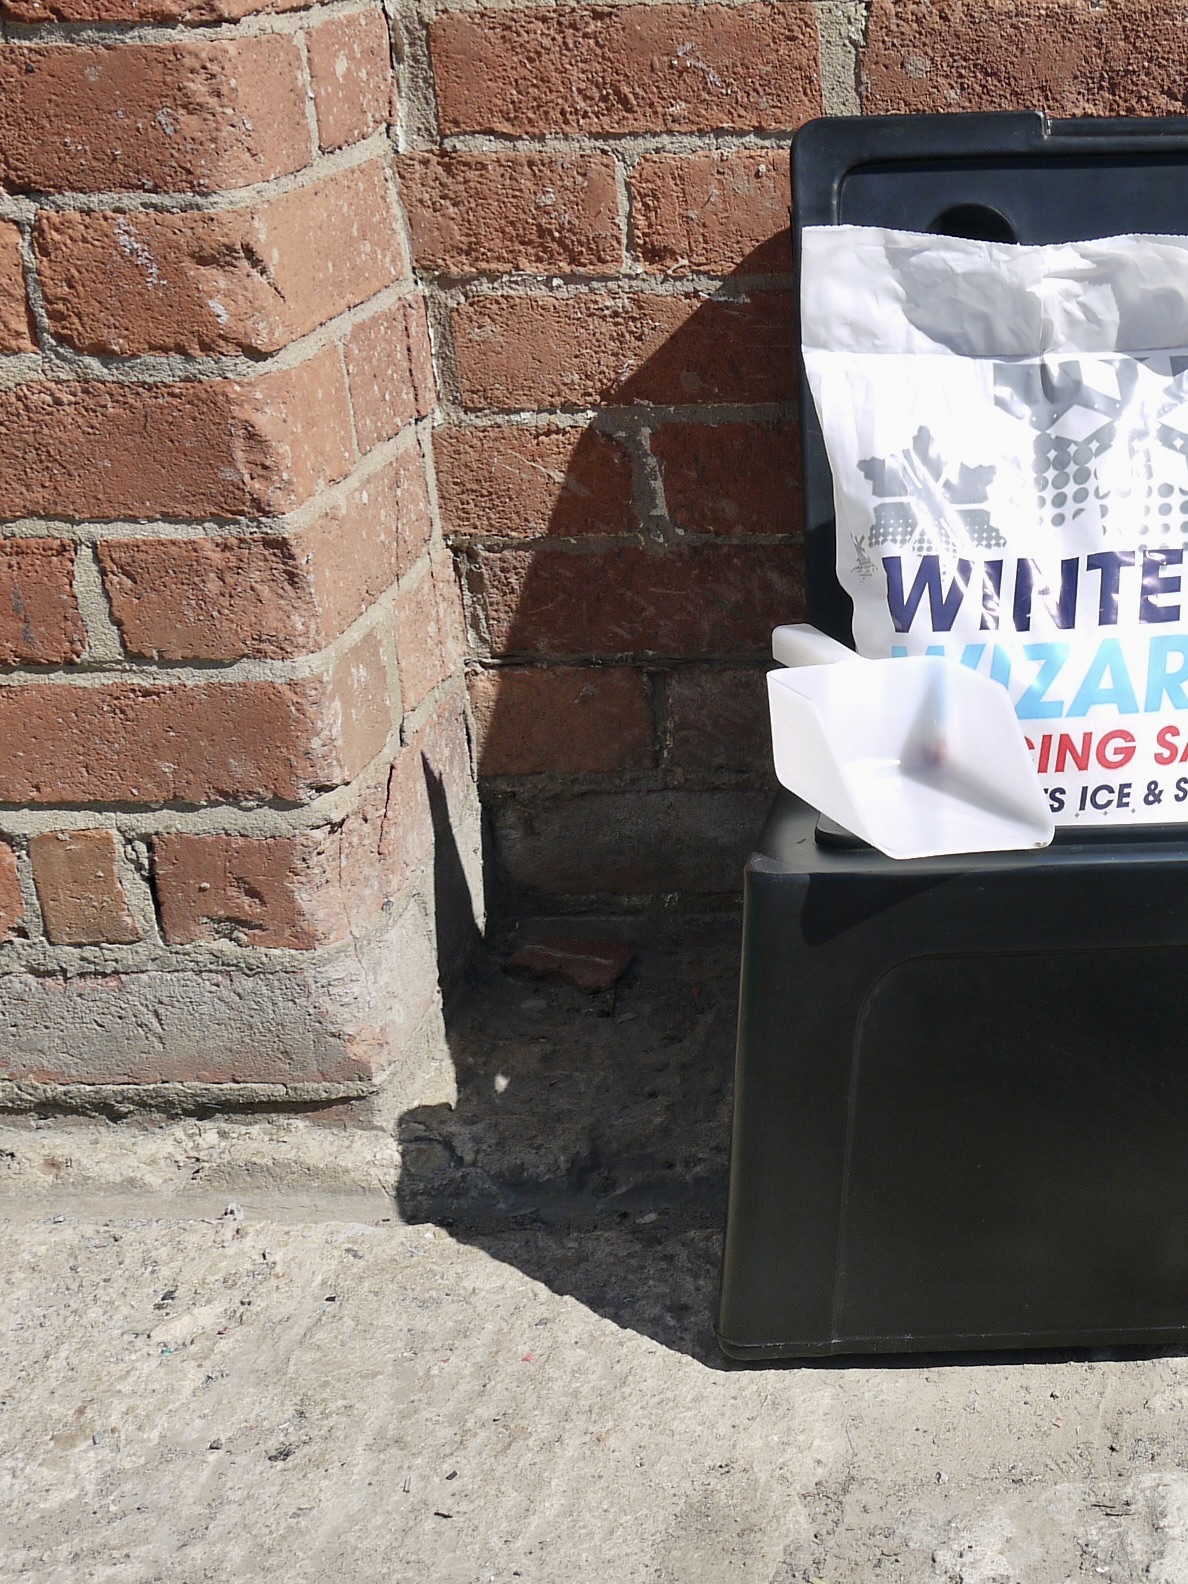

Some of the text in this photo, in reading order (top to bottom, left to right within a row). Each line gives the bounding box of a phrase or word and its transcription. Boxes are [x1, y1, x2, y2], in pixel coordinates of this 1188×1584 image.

[1024, 729, 1136, 774] ING
[1079, 783, 1132, 811] ICE
[1143, 780, 1164, 806] &
